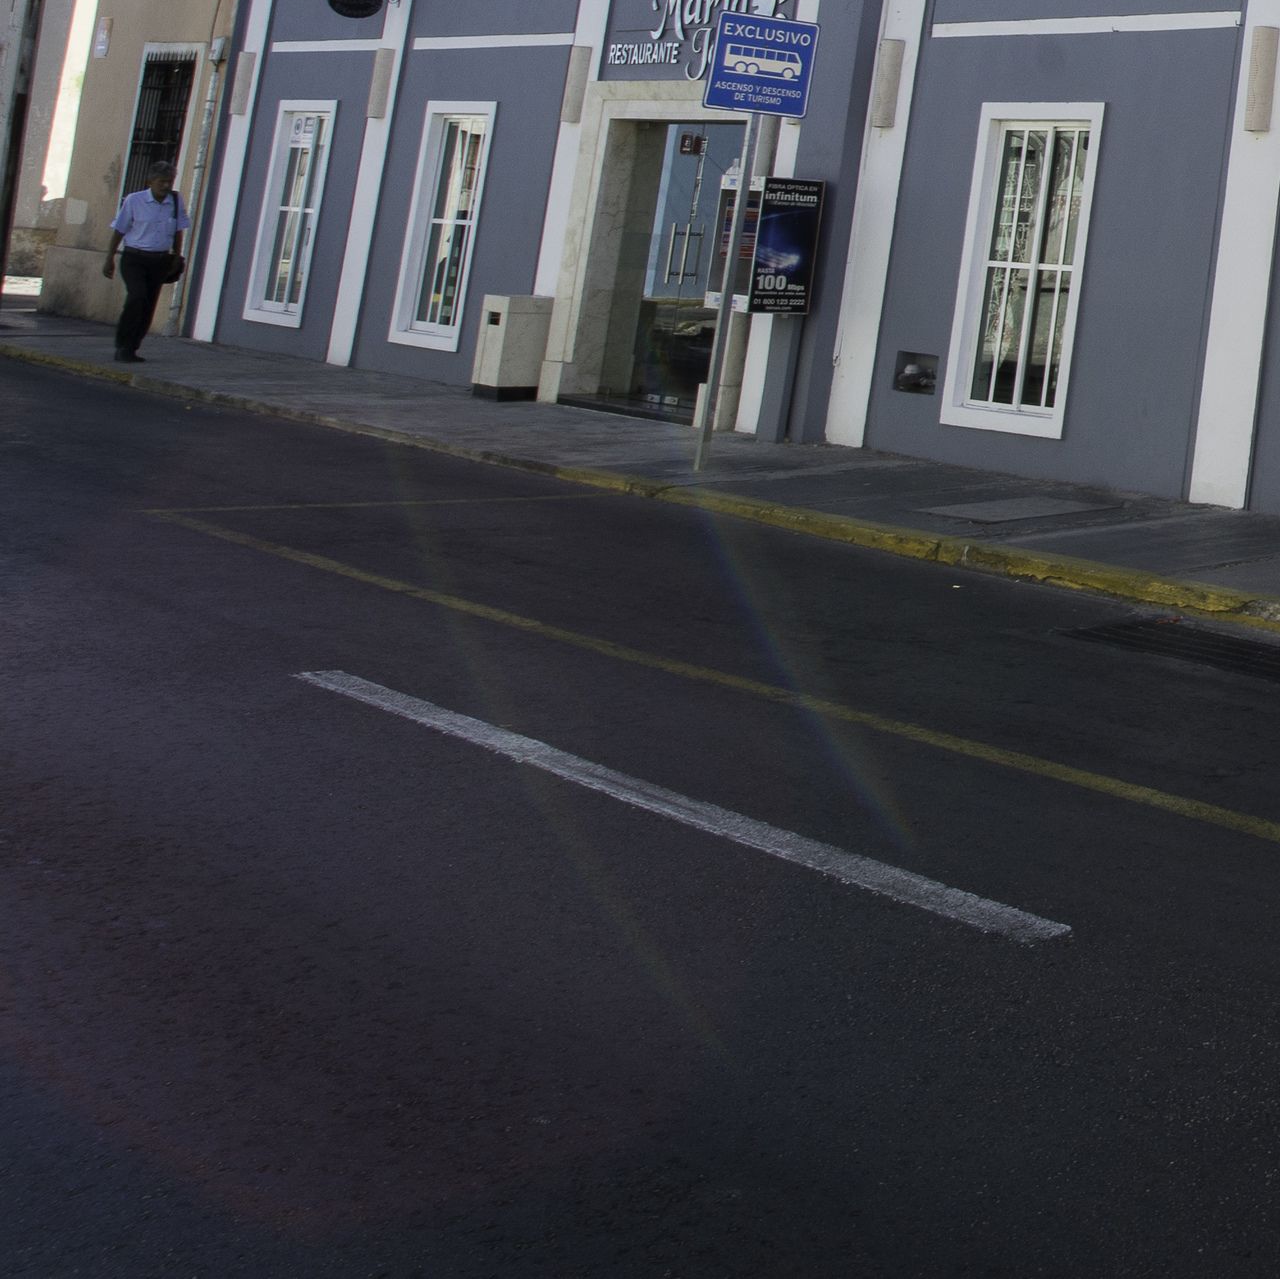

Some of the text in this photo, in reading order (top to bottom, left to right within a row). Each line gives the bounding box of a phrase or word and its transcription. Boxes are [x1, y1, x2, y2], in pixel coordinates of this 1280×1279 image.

[723, 22, 812, 47] EXCLUSIVO
[608, 42, 679, 65] RESTAURANTE
[715, 81, 802, 99] ASCENSO Y DESCENSO
[733, 92, 782, 106] DE TURISMO
[765, 191, 818, 202] infinitum
[756, 274, 787, 290] 100
